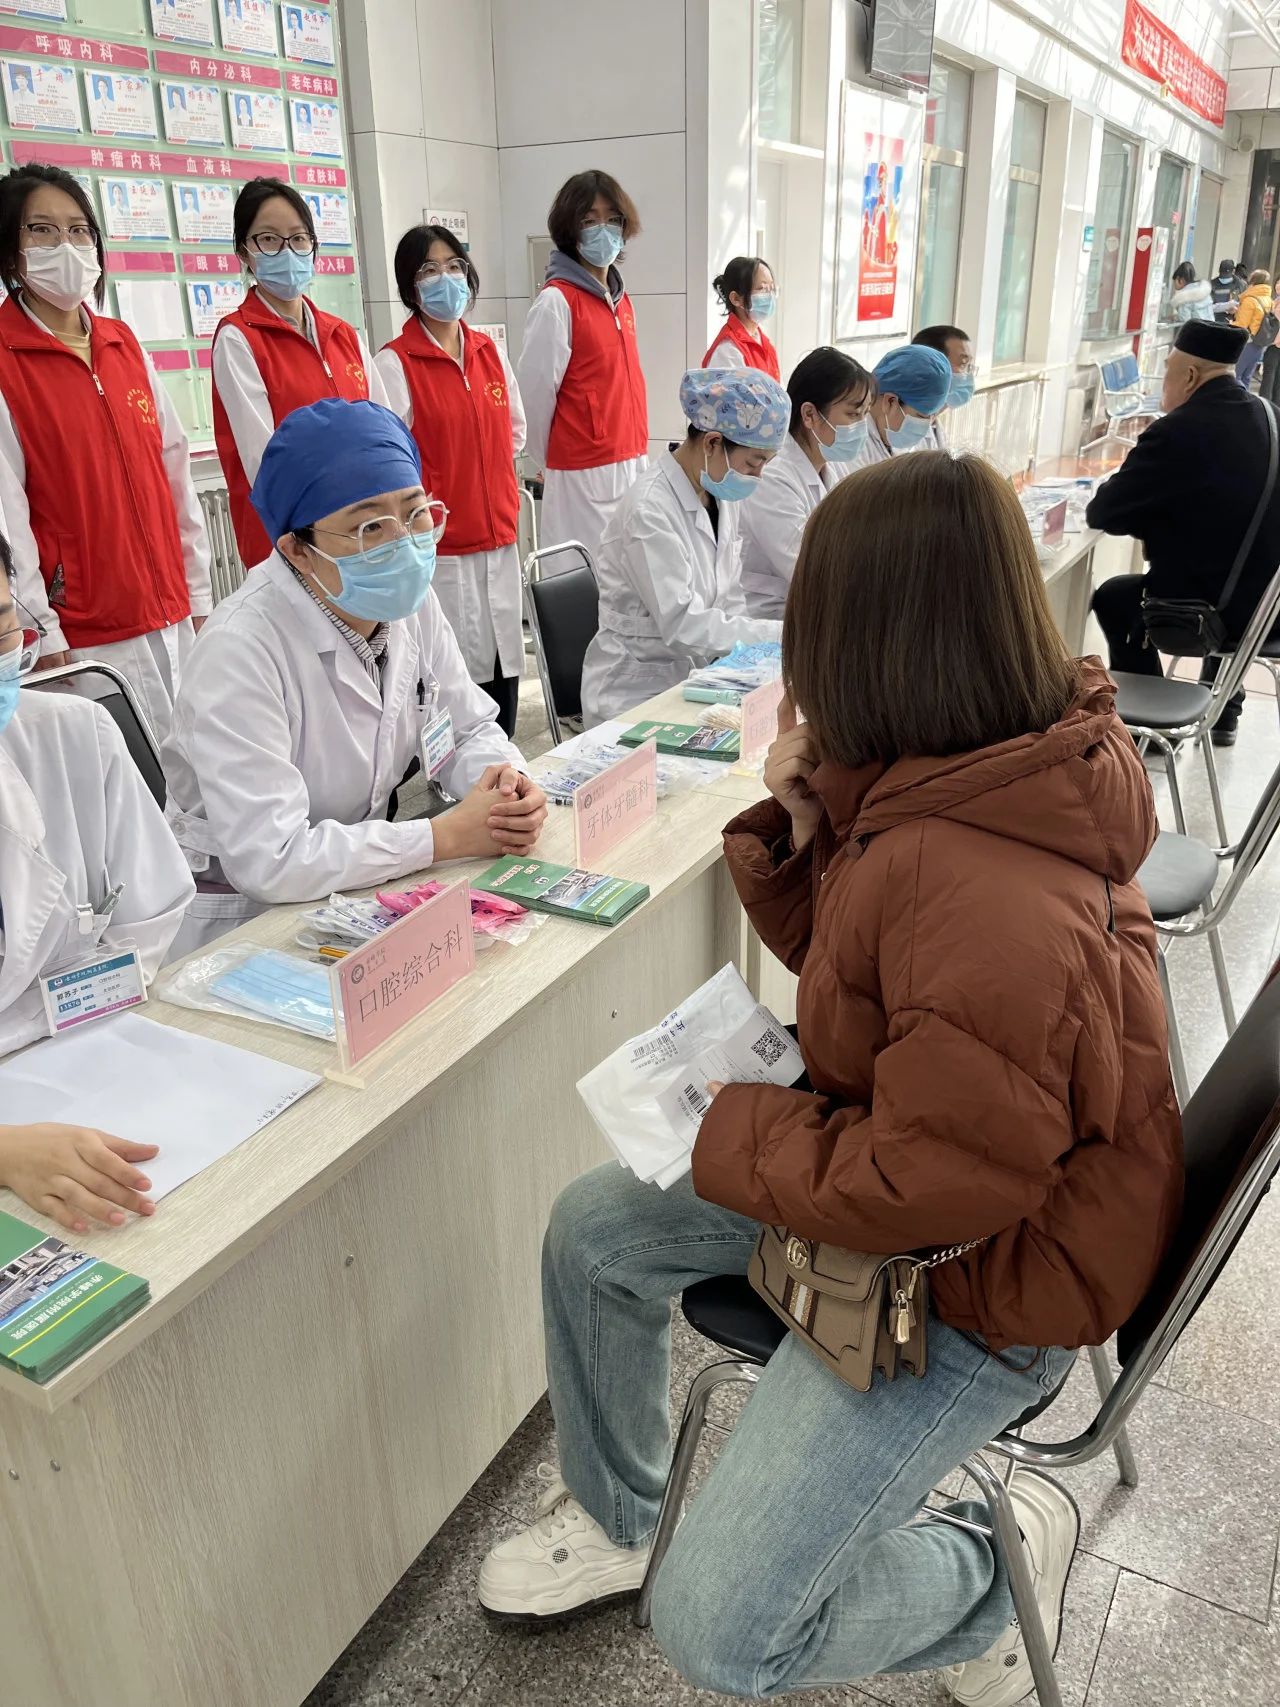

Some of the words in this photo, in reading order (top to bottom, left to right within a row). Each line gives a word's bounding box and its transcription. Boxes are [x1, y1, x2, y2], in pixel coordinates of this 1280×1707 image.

[35, 34, 114, 63] 呼吸内科
[189, 58, 252, 82] 内分泌科
[291, 74, 334, 95] 老年病科
[90, 149, 162, 172] 肿瘤内科
[186, 157, 232, 176] 血液科
[306, 169, 337, 185] 皮肤科
[196, 255, 229, 272] 眼科
[316, 258, 346, 272] 介入科
[587, 775, 649, 841] 牙体牙髓科
[359, 923, 463, 1023] 口腔综合科
[11, 1274, 104, 1340] 赤峰学院附属医院
